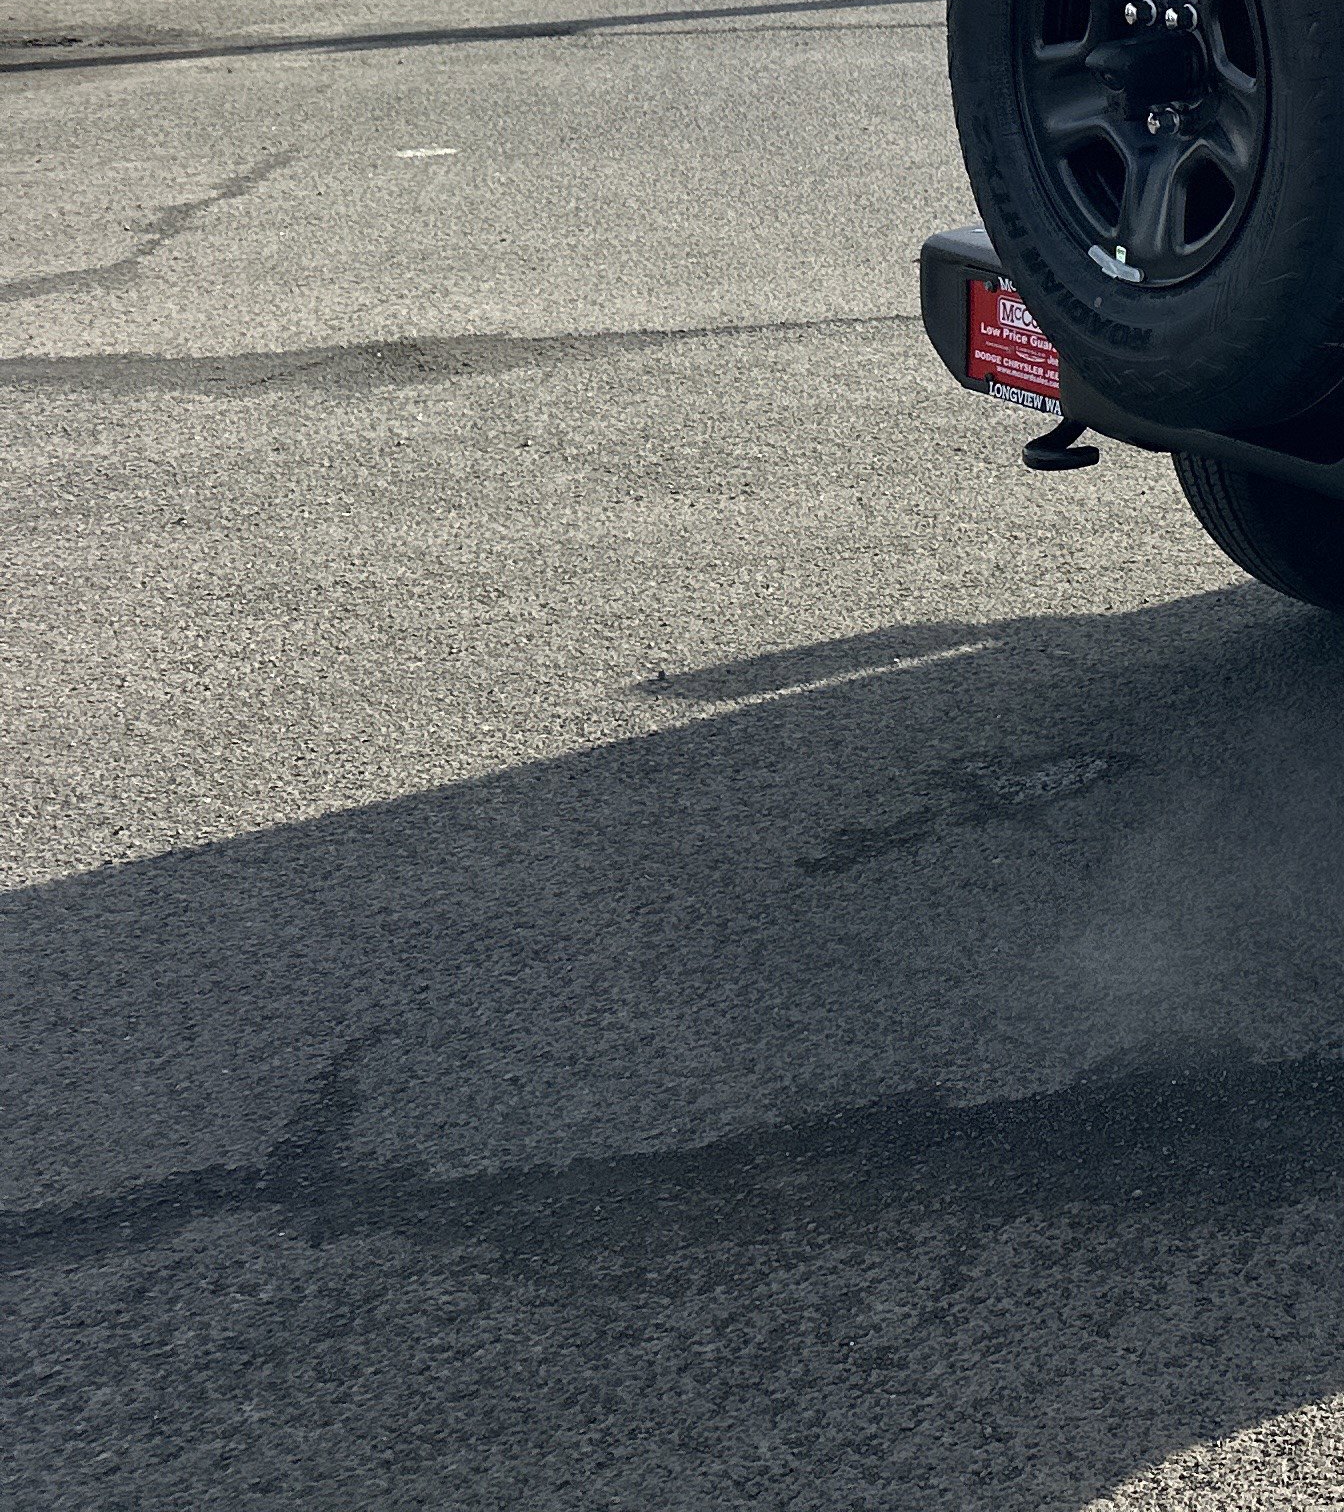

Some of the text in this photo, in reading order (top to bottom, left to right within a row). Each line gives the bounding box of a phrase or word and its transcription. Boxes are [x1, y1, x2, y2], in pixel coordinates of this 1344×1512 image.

[980, 322, 1001, 337] Low
[1003, 329, 1028, 345] Price
[975, 350, 1002, 365] DODGE
[1003, 358, 1044, 377] CHRYSLER
[989, 381, 1062, 416] LONGVIEW WA
